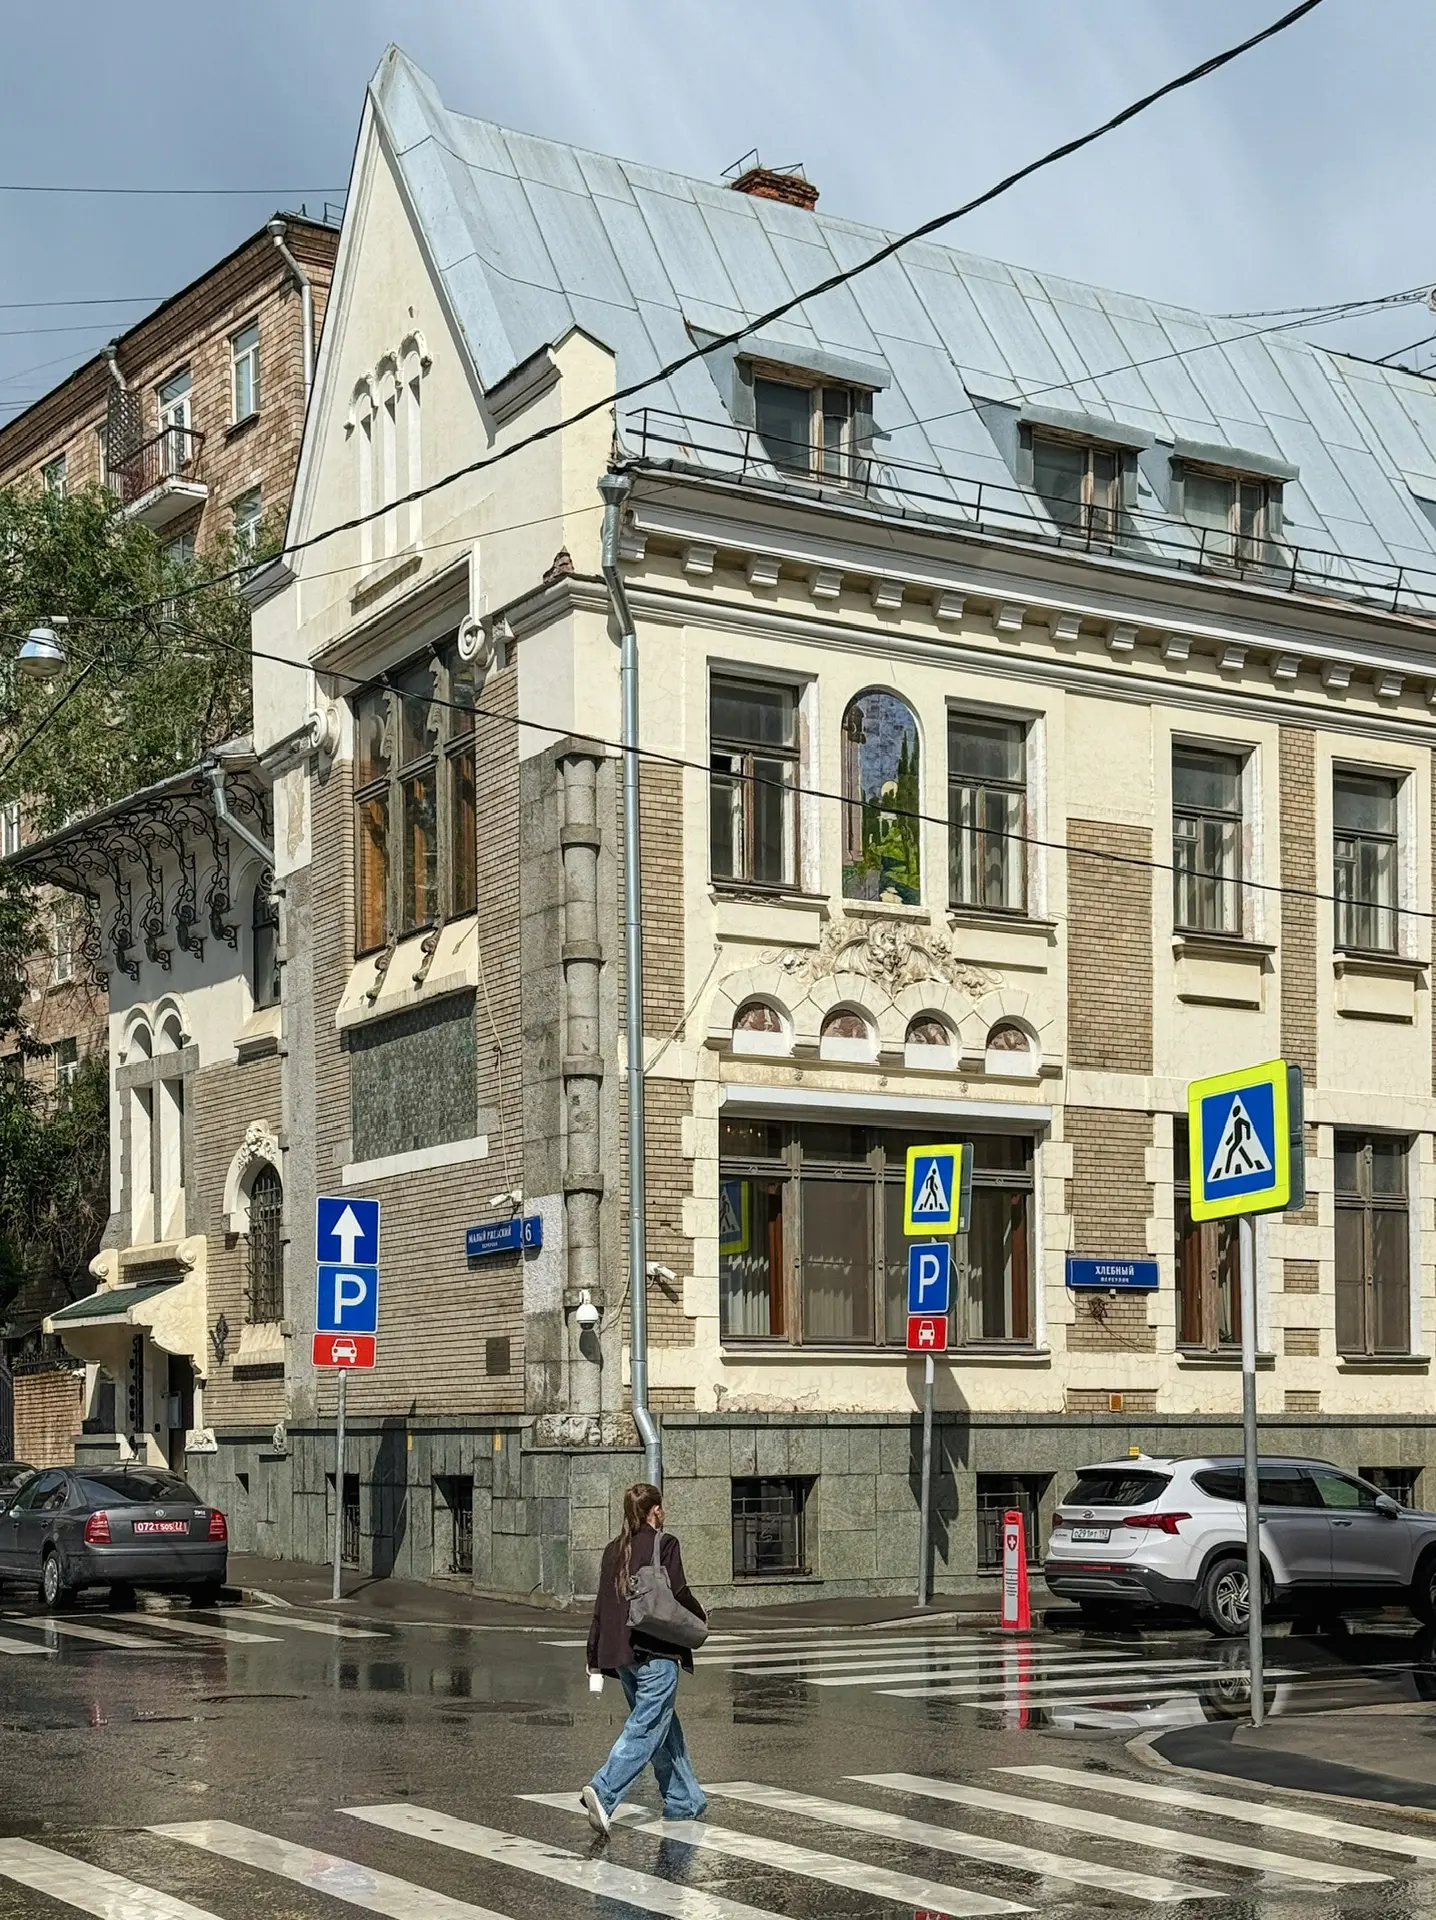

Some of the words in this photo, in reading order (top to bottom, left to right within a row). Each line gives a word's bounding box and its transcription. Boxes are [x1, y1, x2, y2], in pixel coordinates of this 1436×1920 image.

[525, 1223, 532, 1241] 6
[918, 1254, 941, 1304] P
[1095, 1265, 1135, 1276] ХЛЕБНЫЙ
[333, 1273, 367, 1325] P
